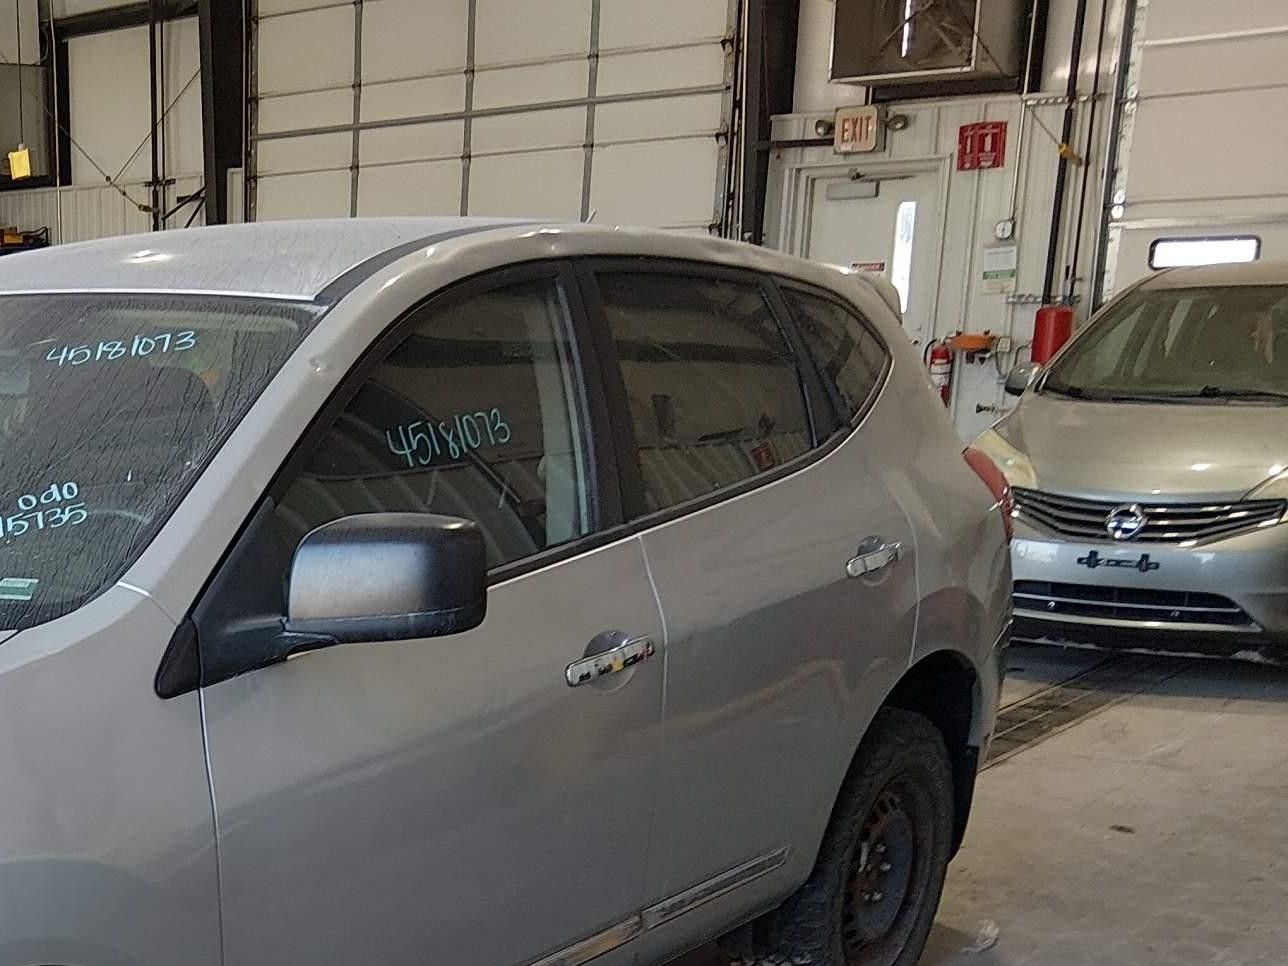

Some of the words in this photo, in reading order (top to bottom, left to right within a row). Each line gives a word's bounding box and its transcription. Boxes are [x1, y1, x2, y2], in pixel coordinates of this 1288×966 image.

[841, 115, 873, 144] EXIT
[46, 330, 196, 367] 45181073
[386, 407, 511, 467] 45181073
